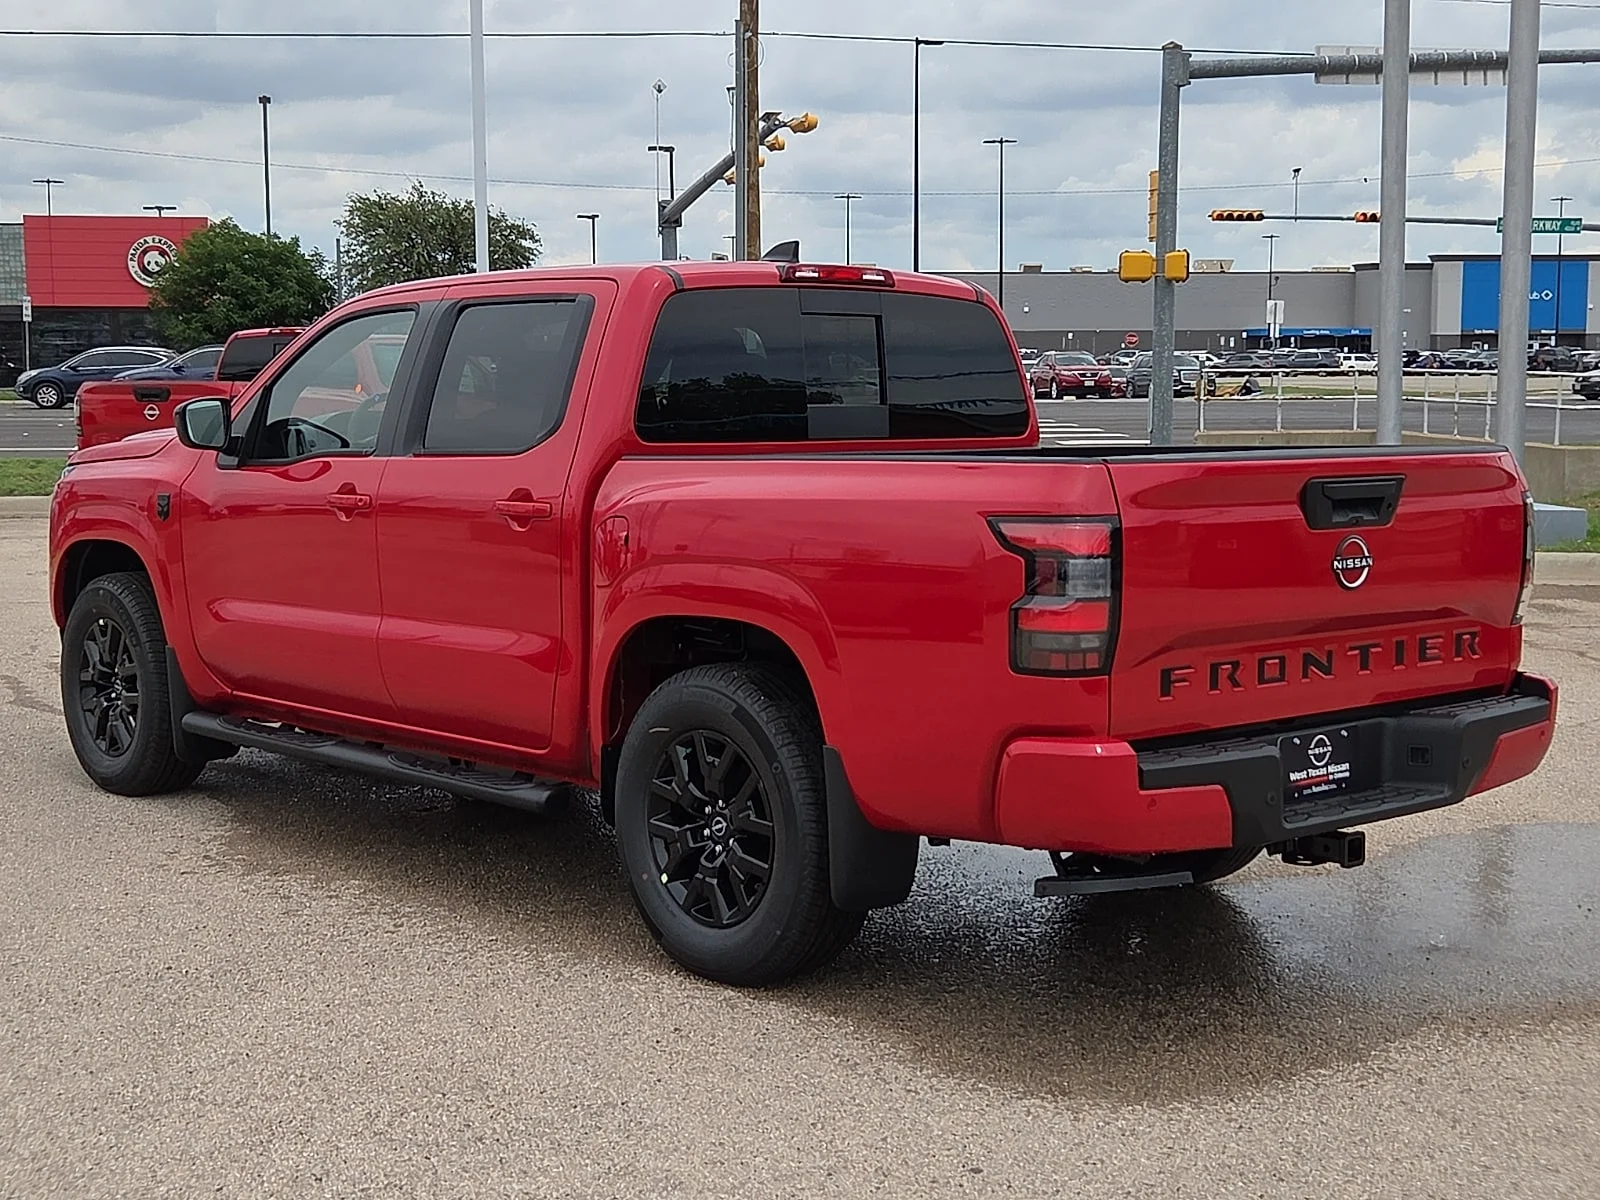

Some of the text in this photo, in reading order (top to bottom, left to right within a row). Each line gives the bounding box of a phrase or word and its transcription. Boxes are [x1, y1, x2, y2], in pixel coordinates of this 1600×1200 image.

[1532, 220, 1561, 231] RKWAY
[130, 237, 178, 262] PANDA EXPRE
[1333, 556, 1373, 570] NISSAN
[1159, 630, 1481, 699] FRONTIER
[1289, 770, 1307, 781] West
[1308, 767, 1327, 777] Texas
[1328, 763, 1350, 773] Nissan
